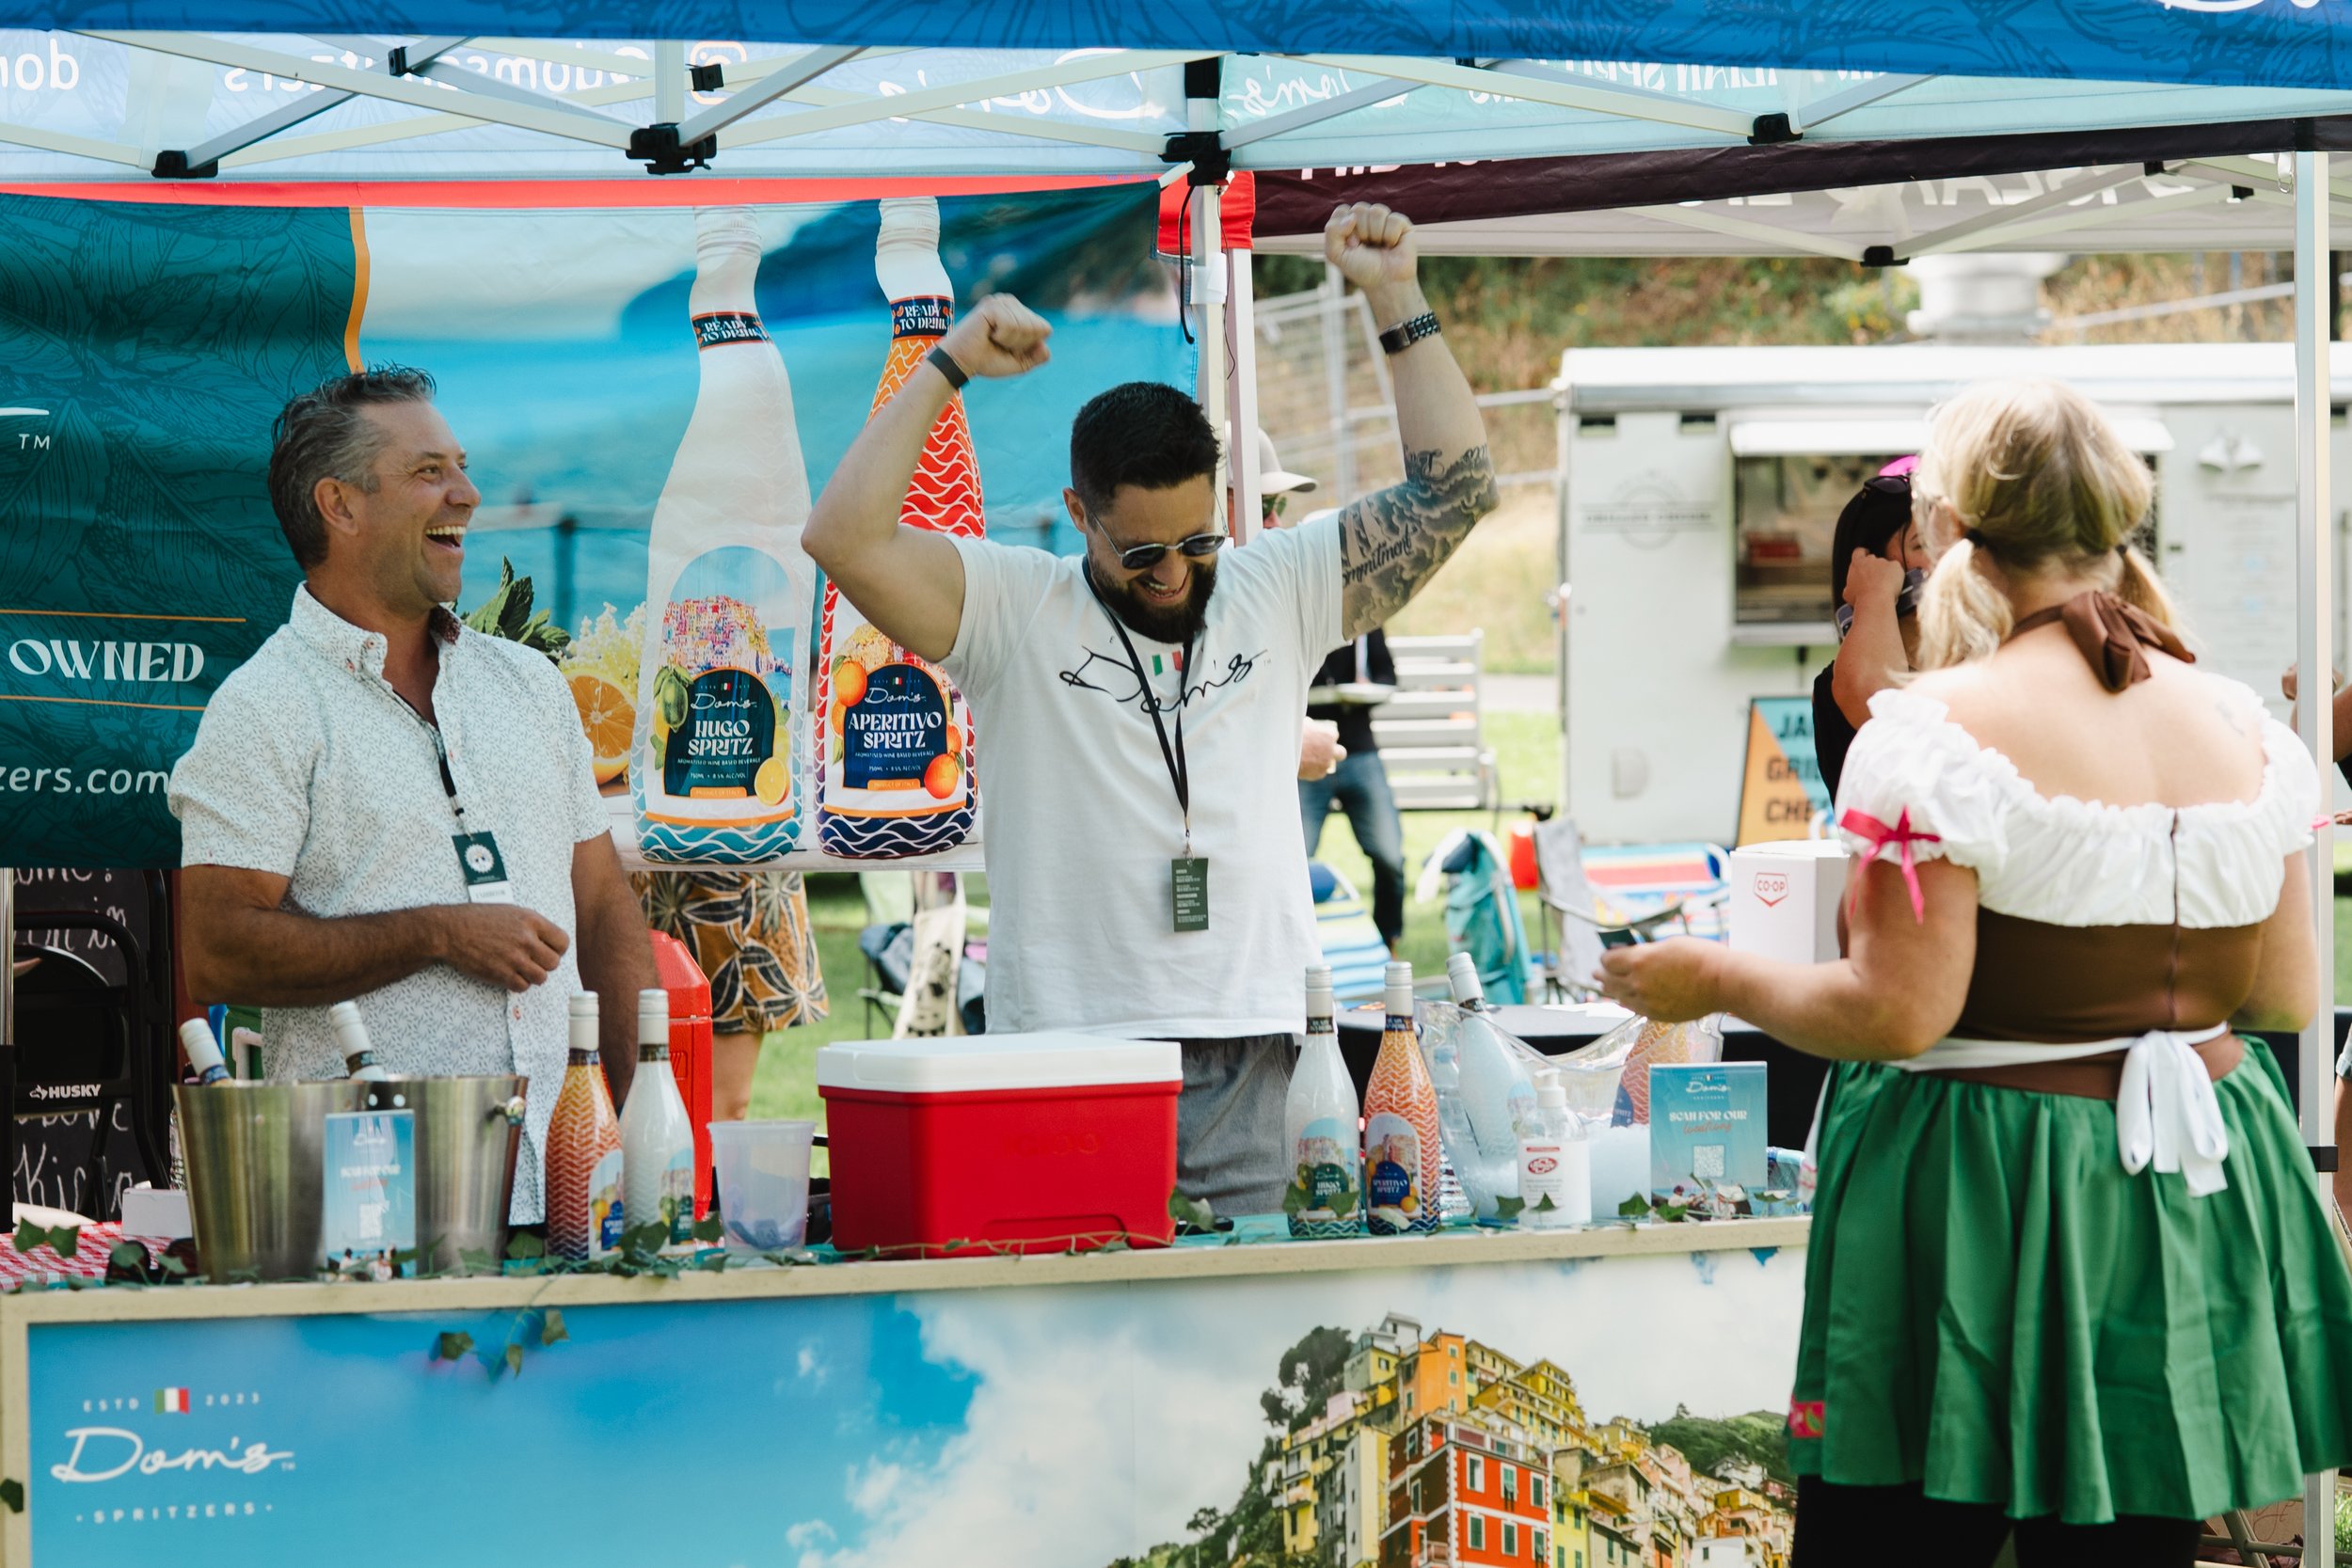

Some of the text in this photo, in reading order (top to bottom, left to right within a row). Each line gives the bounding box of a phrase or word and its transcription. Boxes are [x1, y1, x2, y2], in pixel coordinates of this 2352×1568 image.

[904, 305, 941, 317] READY
[704, 320, 747, 332] READY
[899, 318, 915, 330] TO
[701, 332, 719, 342] TO
[8, 639, 204, 682] OWNED
[691, 693, 757, 709] Dom's
[865, 688, 927, 704] Dom's
[695, 720, 750, 737] HUGO
[849, 711, 942, 731] APERITIVO
[688, 737, 753, 756] SPRITZ
[864, 731, 926, 749] SPRITZ
[0, 757, 169, 795] ers.com
[49, 1085, 102, 1099] HUSKY
[1698, 1111, 1722, 1121] FOR
[1723, 1110, 1747, 1120] OUR
[83, 1392, 260, 1412] ESTD 2023
[51, 1426, 294, 1483] Dom's
[94, 1501, 255, 1524] SPRITZERS
